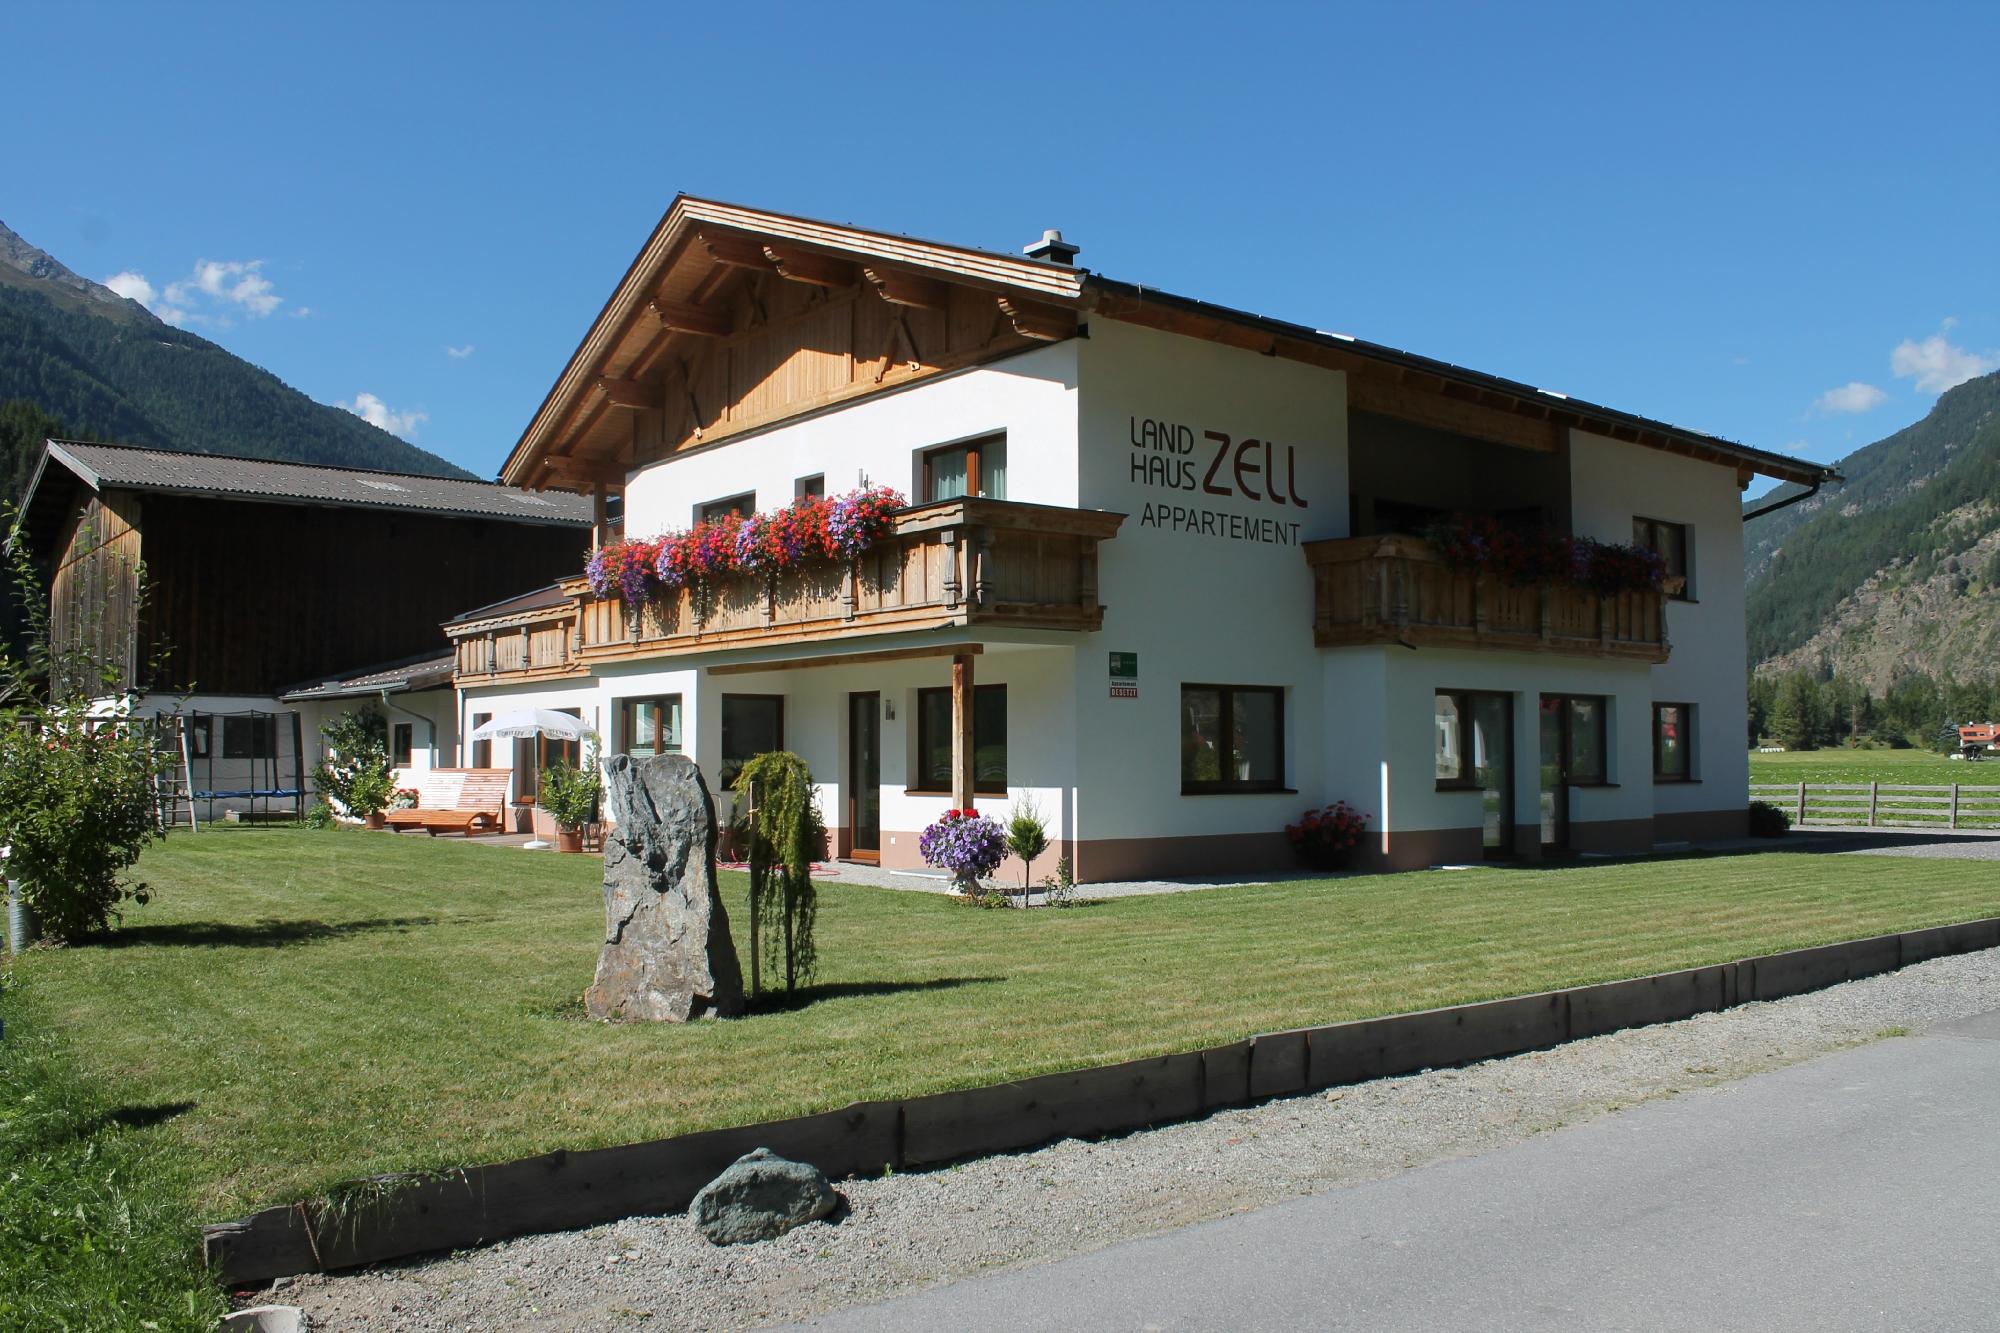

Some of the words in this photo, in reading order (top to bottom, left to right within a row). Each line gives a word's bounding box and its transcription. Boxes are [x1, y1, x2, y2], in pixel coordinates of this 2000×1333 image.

[1130, 416, 1195, 455] LAND
[1130, 452, 1197, 491] HAUS
[1202, 430, 1308, 508] ZELL
[1140, 502, 1301, 546] APPARTEMENT
